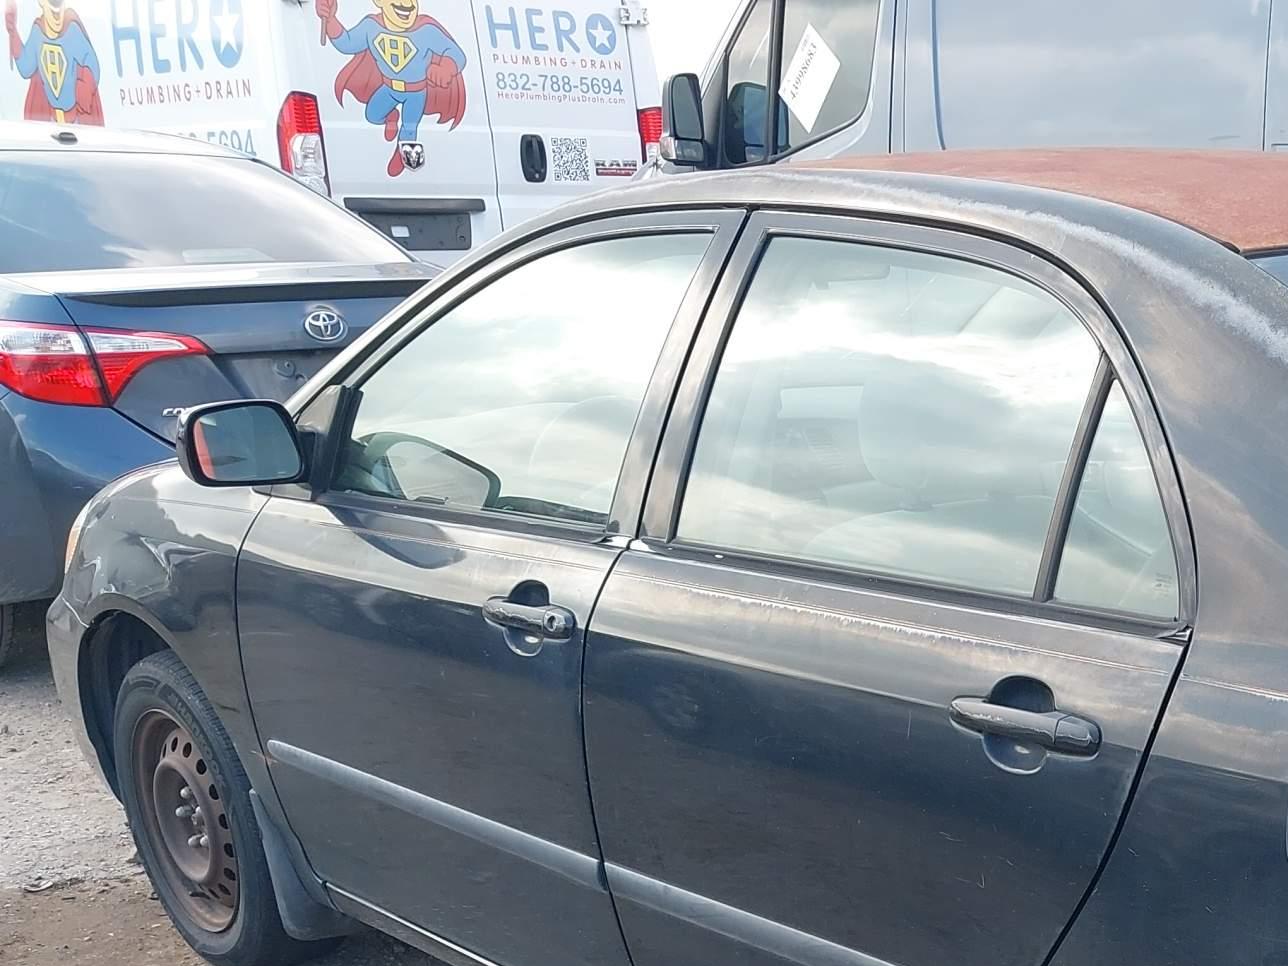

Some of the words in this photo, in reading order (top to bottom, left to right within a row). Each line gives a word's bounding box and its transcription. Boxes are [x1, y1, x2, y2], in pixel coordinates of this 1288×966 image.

[111, 0, 244, 78] HERO
[485, 4, 617, 56] HERO
[495, 71, 625, 96] 832-788-5694
[496, 90, 627, 105] HeroPlumbingPlusDrain.com
[594, 159, 638, 168] RAM
